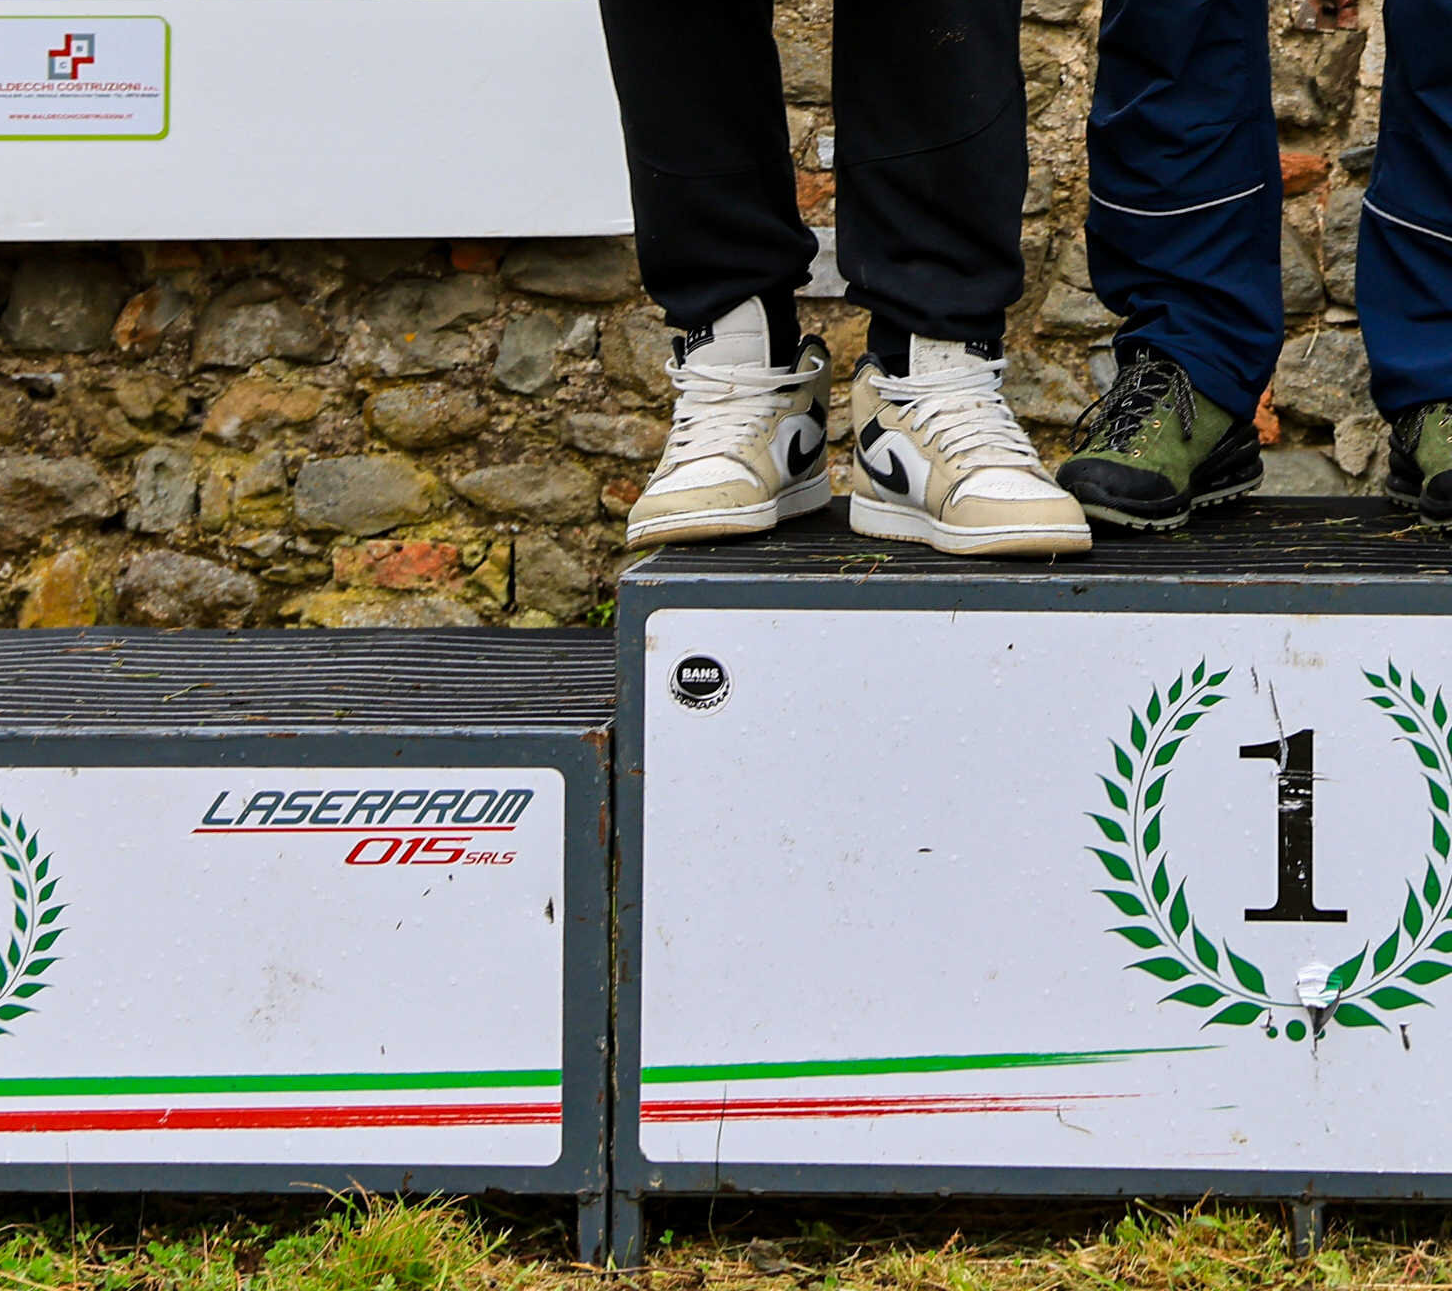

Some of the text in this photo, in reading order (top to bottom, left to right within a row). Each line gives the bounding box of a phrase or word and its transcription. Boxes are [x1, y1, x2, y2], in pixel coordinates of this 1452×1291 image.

[57, 83, 141, 91] COSTRUZIONI
[682, 668, 719, 679] BANS
[201, 786, 536, 827] LASERPROM
[1238, 728, 1349, 923] 1
[462, 849, 517, 866] SRLS
